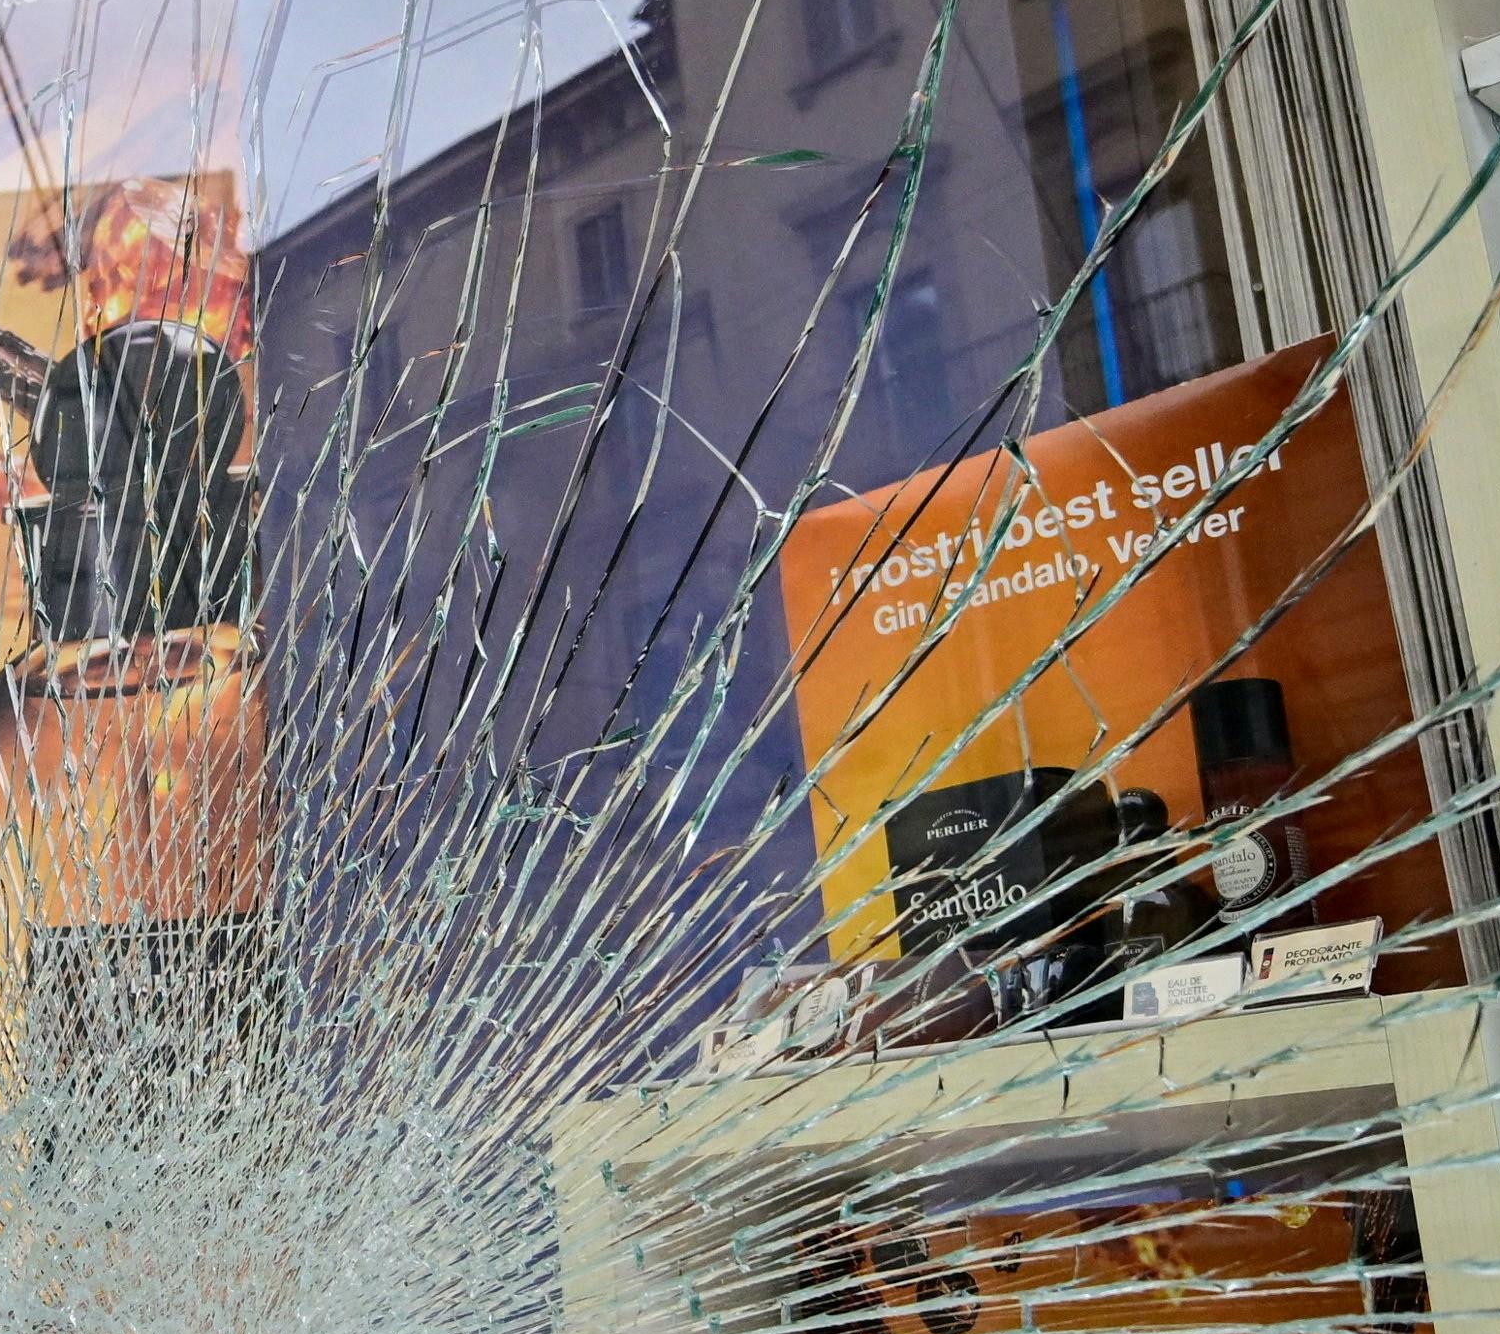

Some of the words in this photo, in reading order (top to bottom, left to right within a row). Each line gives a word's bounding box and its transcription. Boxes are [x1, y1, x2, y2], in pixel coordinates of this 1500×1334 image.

[830, 566, 843, 606] i
[852, 518, 984, 599] nostri
[1001, 478, 1117, 550] best
[1131, 437, 1290, 510] seller
[926, 817, 989, 841] PERLIER
[909, 873, 1028, 925] Sandalo
[1285, 940, 1362, 959] DEODORANTE
[1284, 950, 1353, 968] PROFUMATO
[1167, 978, 1187, 989] EAU
[1190, 975, 1203, 986] DE
[1331, 972, 1363, 985] 6,90
[1167, 985, 1209, 999] TOILETTE
[1167, 993, 1216, 1007] SANDALO
